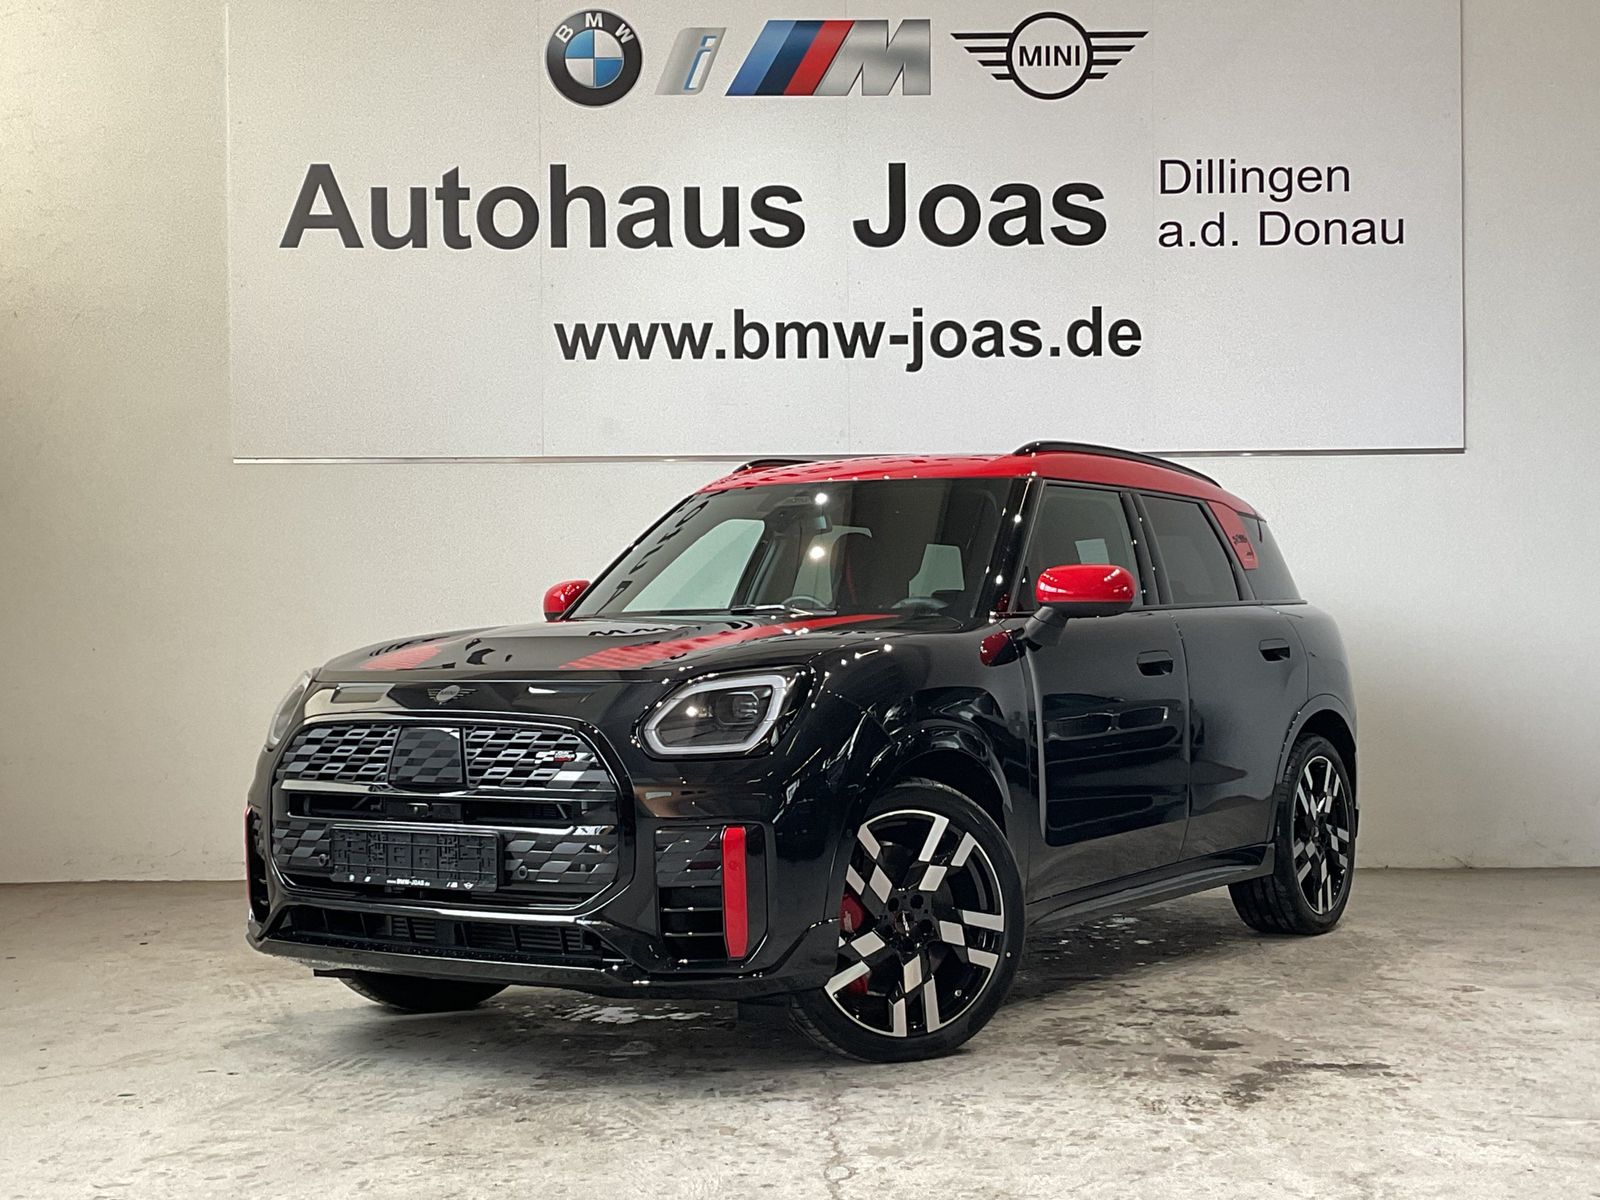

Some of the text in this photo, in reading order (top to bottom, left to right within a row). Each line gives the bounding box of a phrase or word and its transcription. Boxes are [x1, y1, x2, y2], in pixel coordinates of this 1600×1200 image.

[555, 12, 635, 45] BMW
[1019, 45, 1081, 67] MINI
[1160, 158, 1350, 203] Dillingen
[279, 162, 1107, 250] Autohaus Joas
[1158, 210, 1404, 248] a.d. Donau
[553, 305, 1142, 373] www.bmw-joas.de
